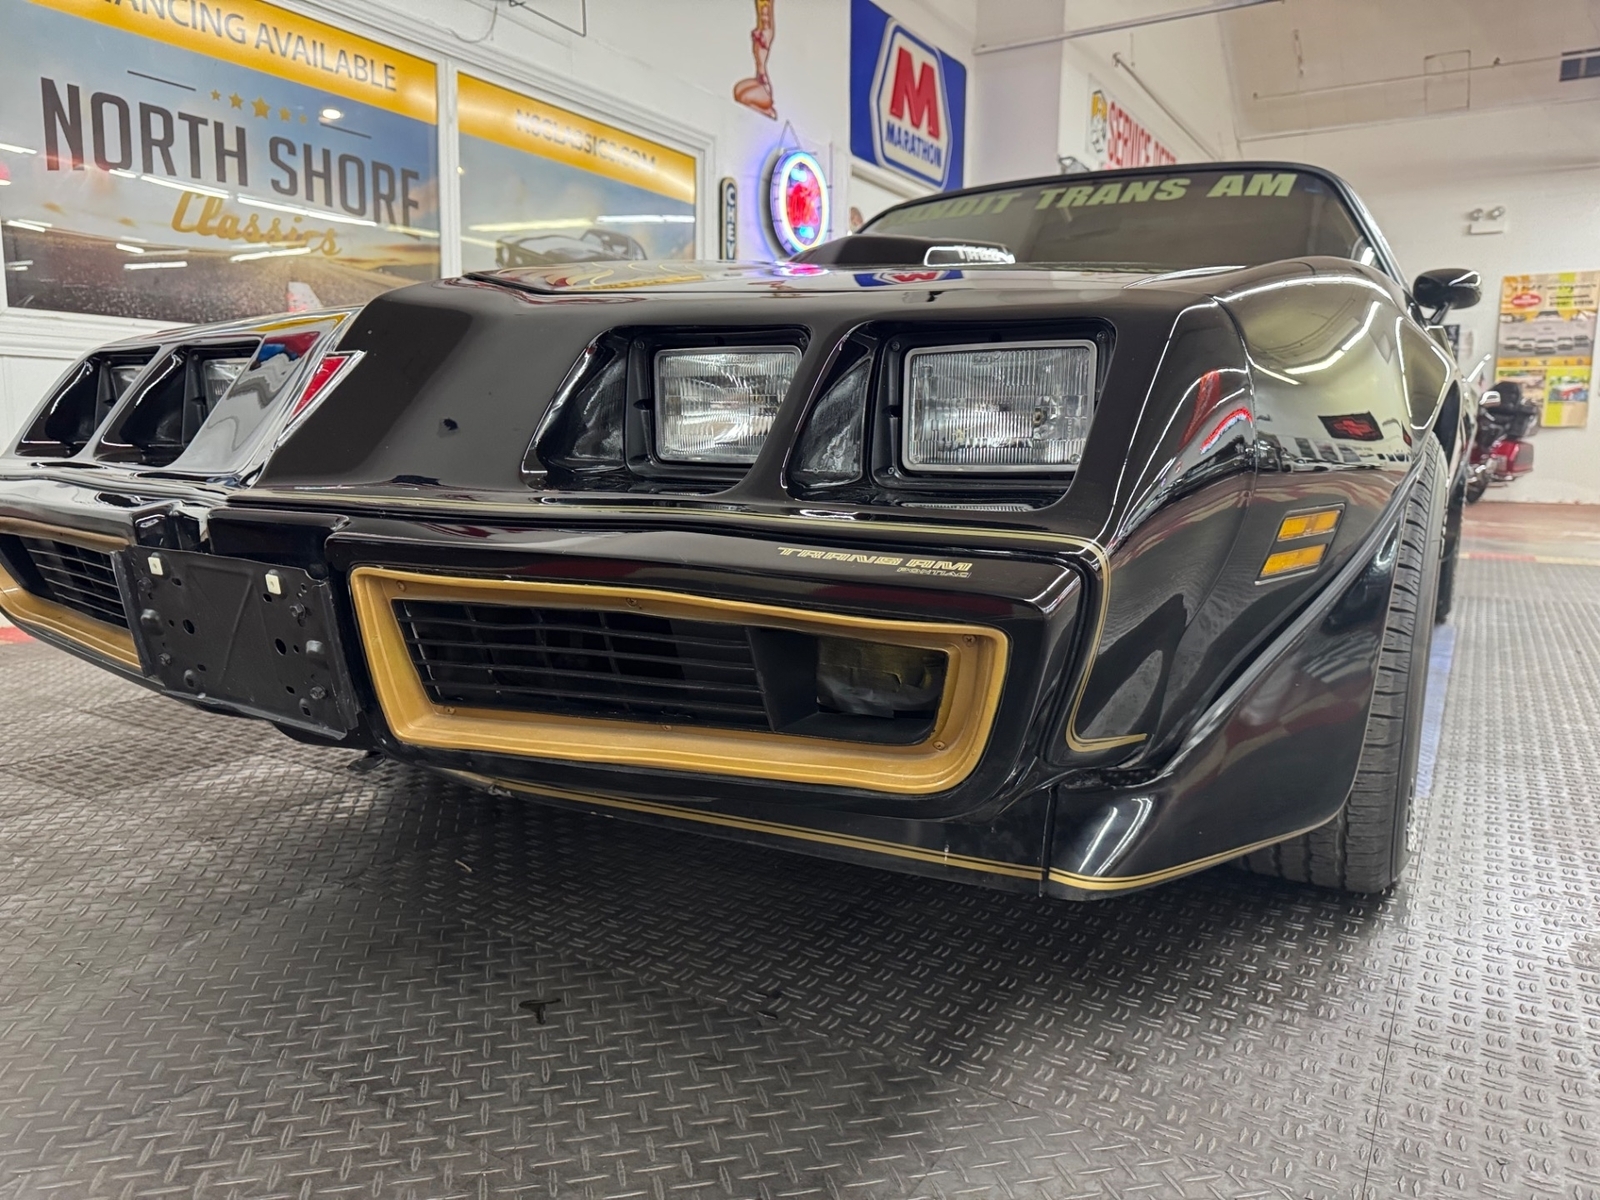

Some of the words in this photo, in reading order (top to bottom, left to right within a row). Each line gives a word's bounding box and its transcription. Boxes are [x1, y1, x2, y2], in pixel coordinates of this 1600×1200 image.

[255, 23, 397, 92] AVAILABLE
[889, 46, 940, 140] M
[41, 76, 248, 187] NORTH
[269, 136, 421, 240] SHORE
[885, 120, 942, 169] MARATHON
[171, 190, 342, 256] Classics
[726, 187, 736, 260] CHEV
[1035, 178, 1191, 210] TRANS
[1206, 173, 1298, 199] AM
[778, 547, 903, 566] TRANS
[905, 558, 972, 571] AM
[897, 567, 971, 578] PONTIAC
